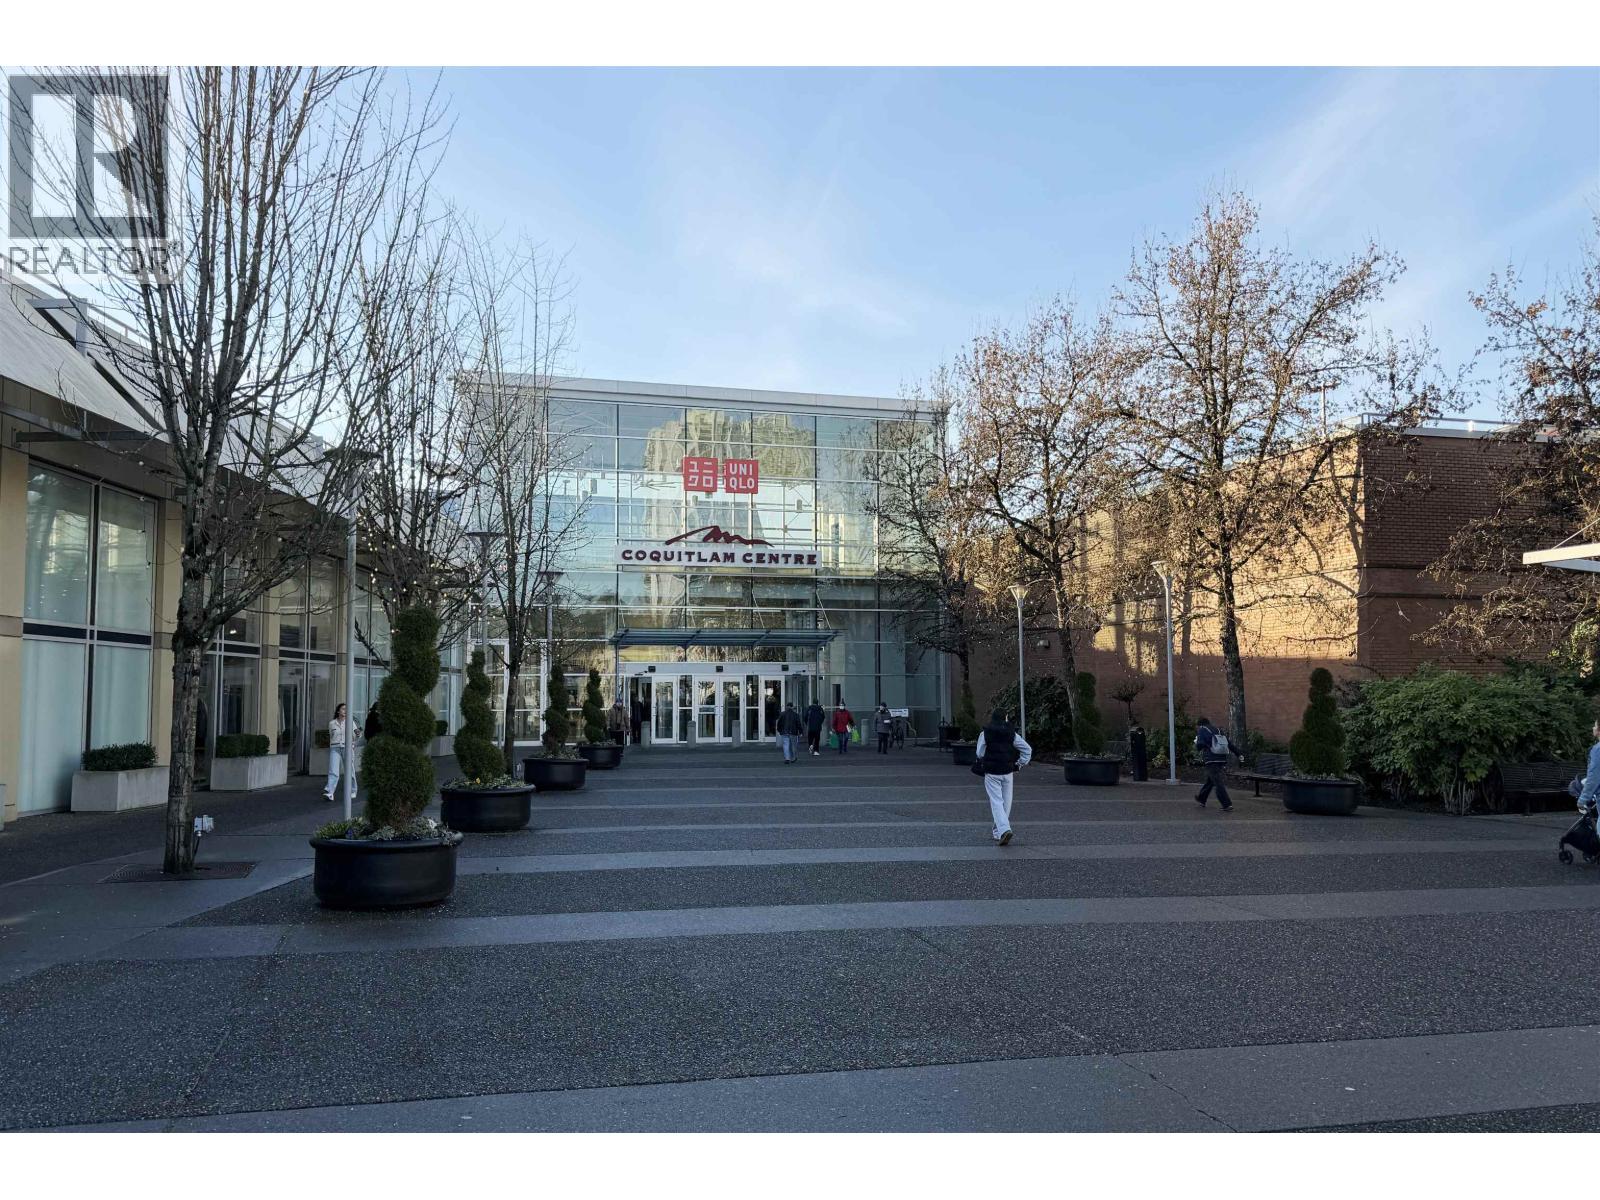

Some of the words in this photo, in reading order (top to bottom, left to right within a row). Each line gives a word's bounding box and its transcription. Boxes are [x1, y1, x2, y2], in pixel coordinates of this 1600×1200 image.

[689, 461, 713, 473] ユニ
[729, 463, 753, 475] UNI
[688, 475, 713, 487] クロ
[729, 476, 755, 490] QLO
[621, 549, 735, 563] COQUITLAM
[742, 552, 817, 565] CENTRE
